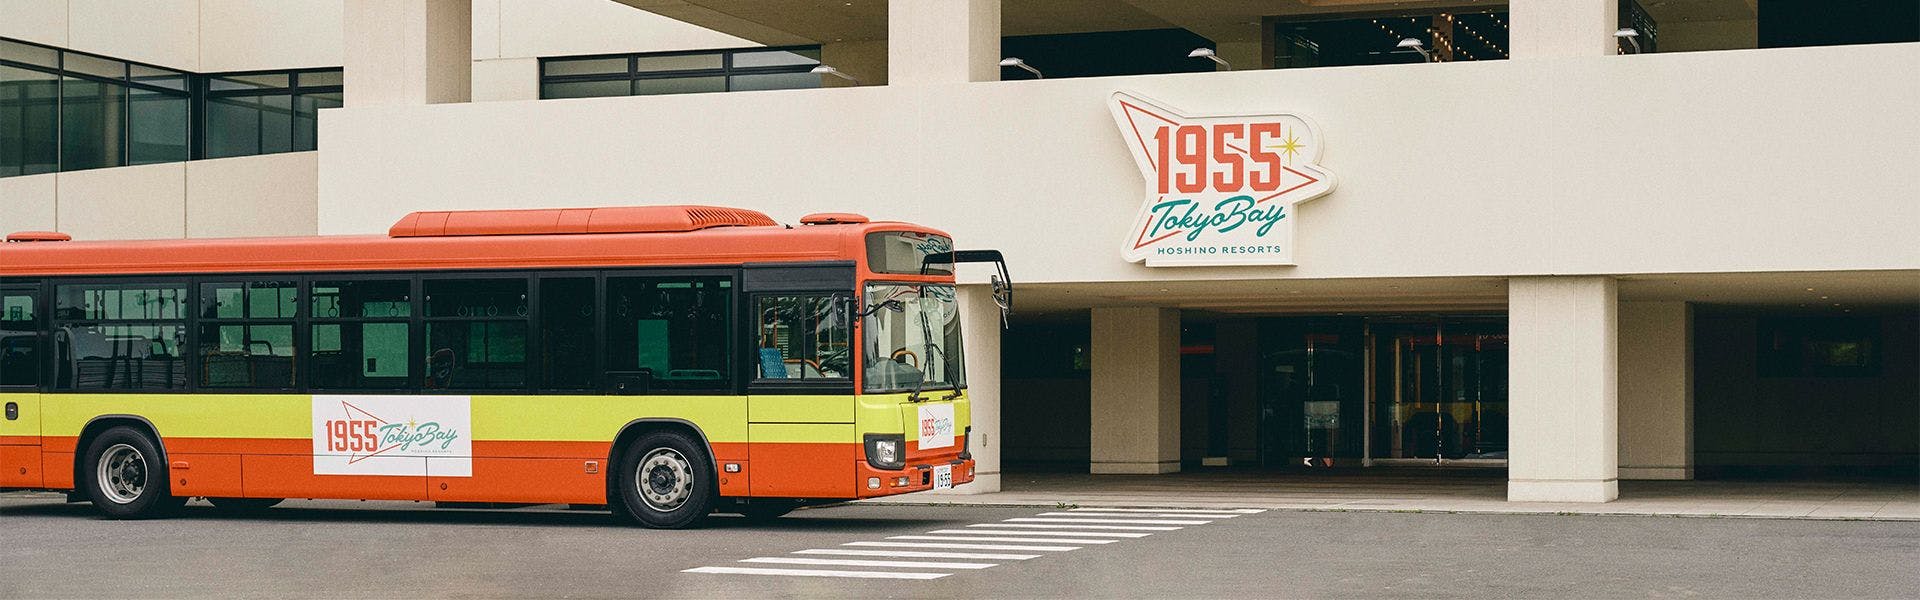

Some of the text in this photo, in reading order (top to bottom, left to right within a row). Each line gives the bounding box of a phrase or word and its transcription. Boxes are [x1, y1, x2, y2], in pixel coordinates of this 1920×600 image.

[1154, 122, 1281, 194] 1955
[1157, 245, 1281, 255] HOSHINO RESORTS
[325, 420, 378, 452] 1955
